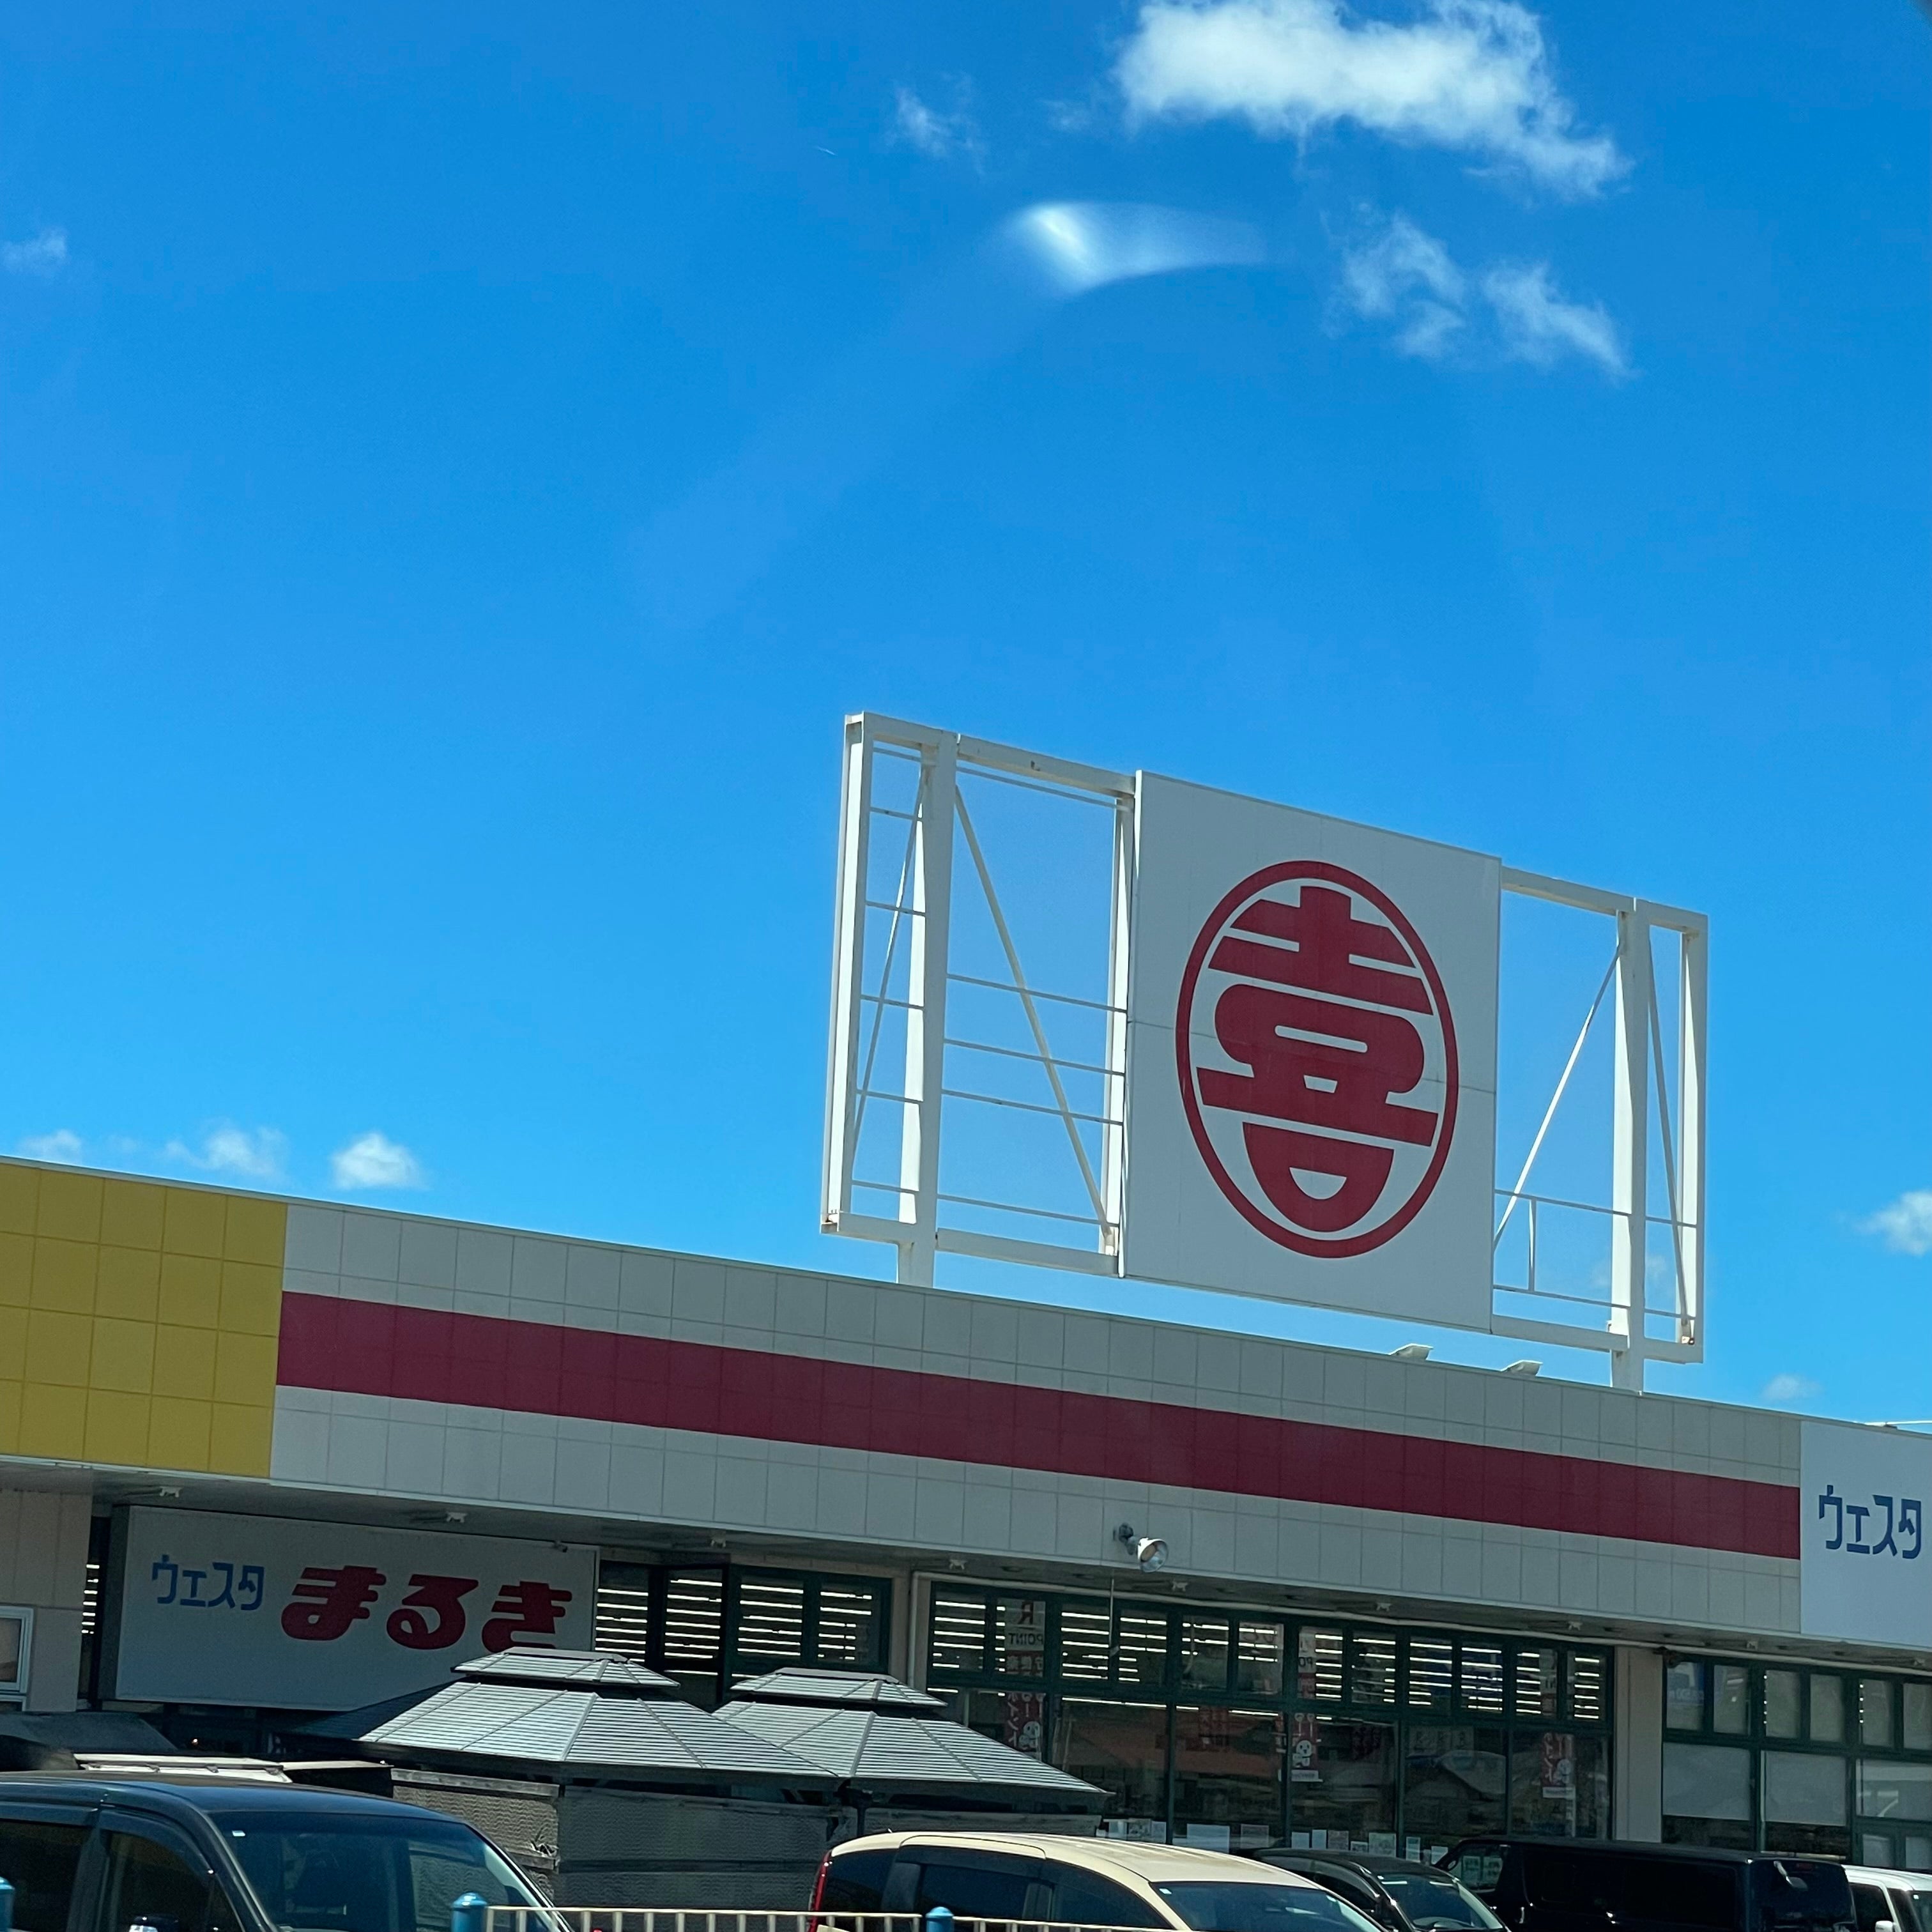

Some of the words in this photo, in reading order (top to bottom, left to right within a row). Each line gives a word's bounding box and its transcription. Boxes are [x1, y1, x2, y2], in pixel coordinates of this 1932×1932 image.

[1818, 1484, 1922, 1560] ウェスタ
[151, 1554, 264, 1611] ウェスタ
[281, 1565, 572, 1653] まるき
